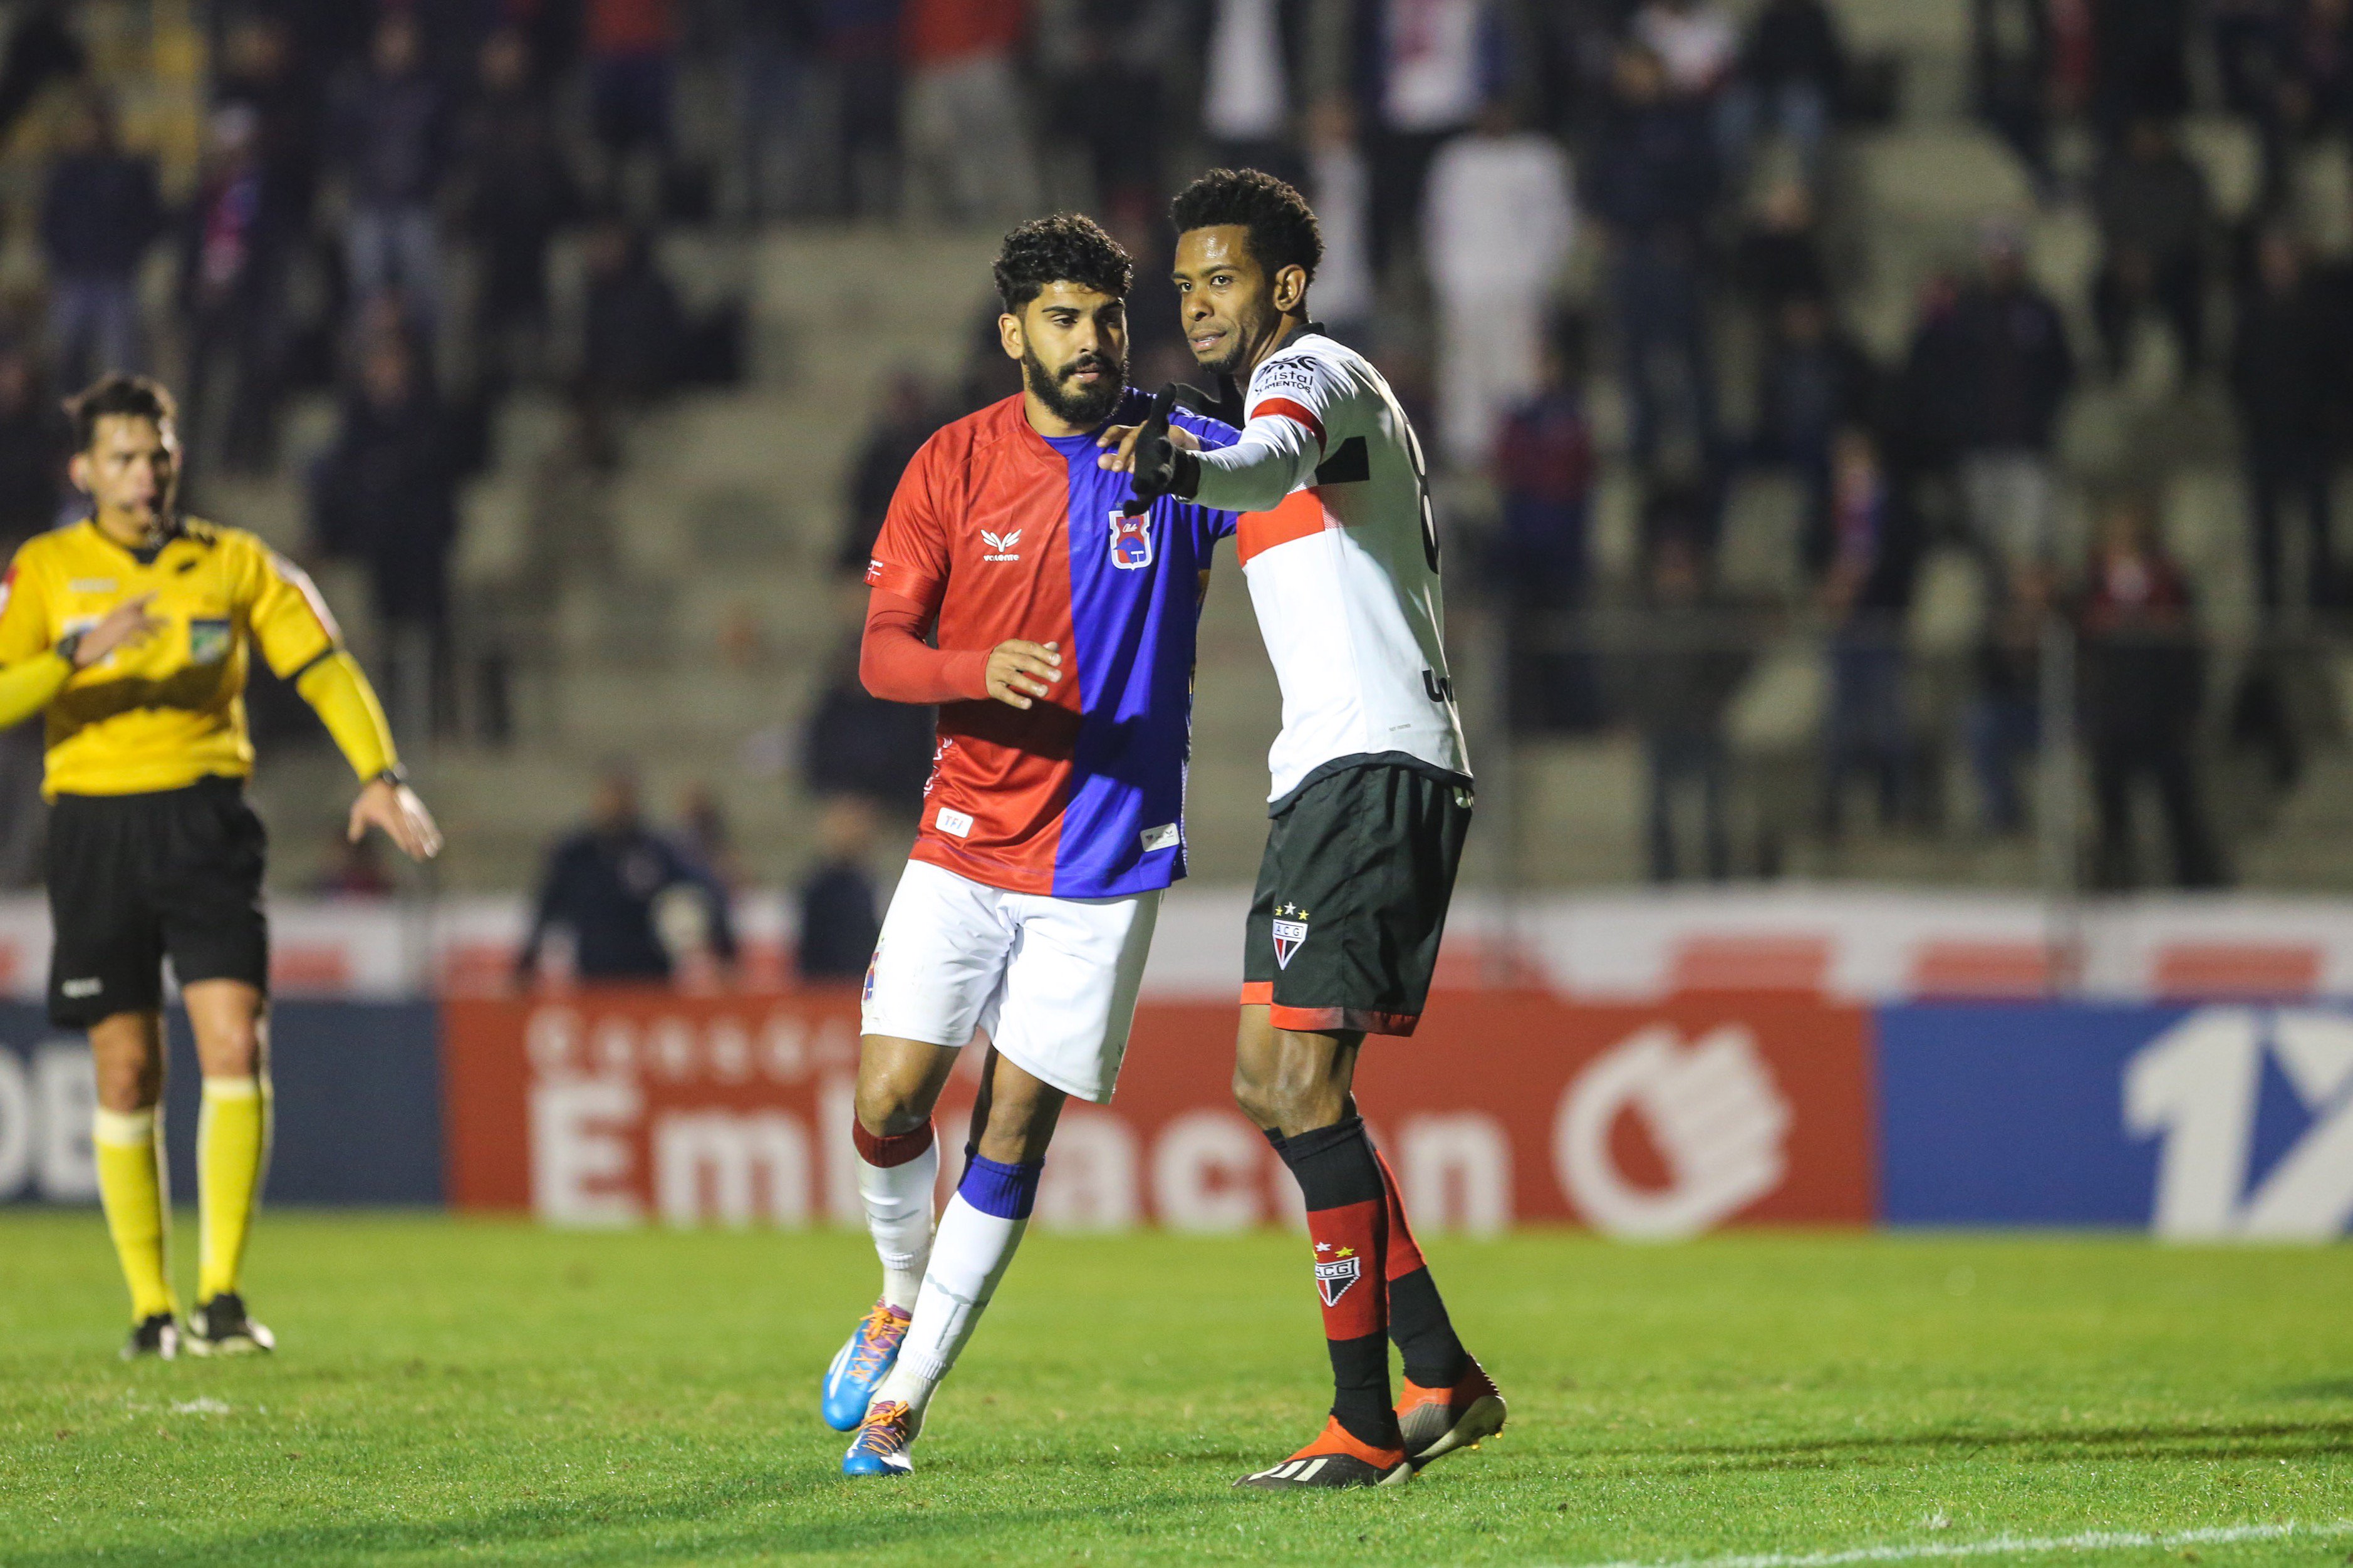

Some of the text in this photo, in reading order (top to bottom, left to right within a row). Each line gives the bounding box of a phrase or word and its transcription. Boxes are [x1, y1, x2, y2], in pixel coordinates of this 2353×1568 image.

[1260, 371, 1313, 385] ristal
[1255, 380, 1311, 395] MENTOS
[529, 1071, 1509, 1229] Emacn
